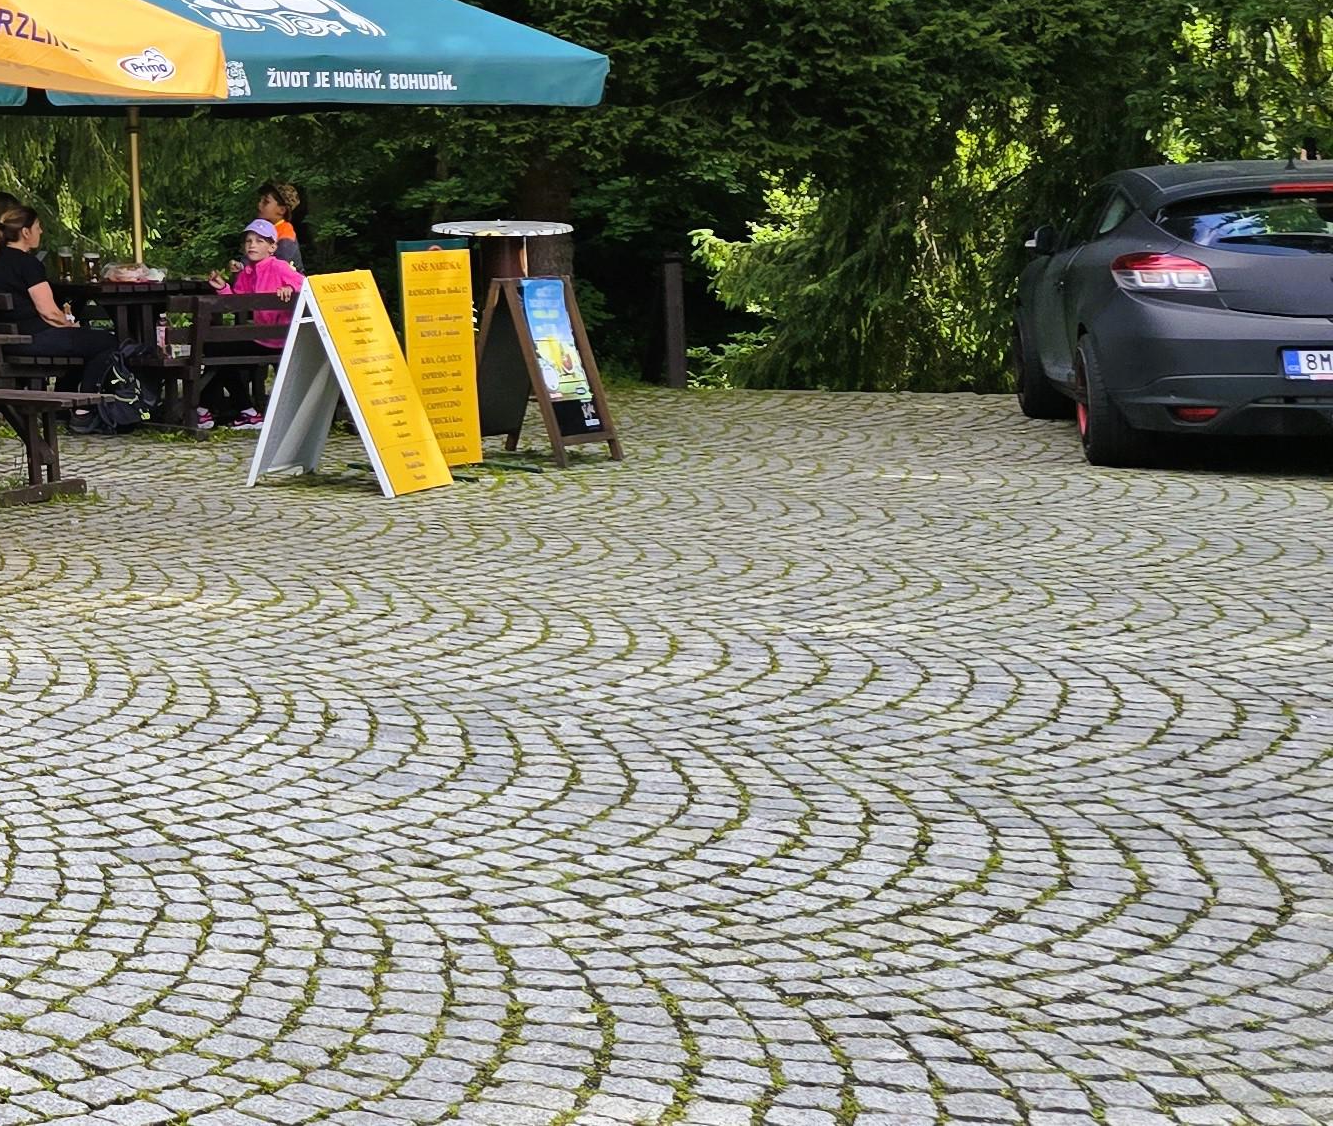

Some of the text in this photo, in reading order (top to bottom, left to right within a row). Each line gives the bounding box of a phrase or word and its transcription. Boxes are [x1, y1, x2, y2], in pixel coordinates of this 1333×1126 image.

[130, 62, 168, 74] Prima
[266, 68, 458, 91] ŽIVOT JE HOŘKÝ. BOHUDÍK.
